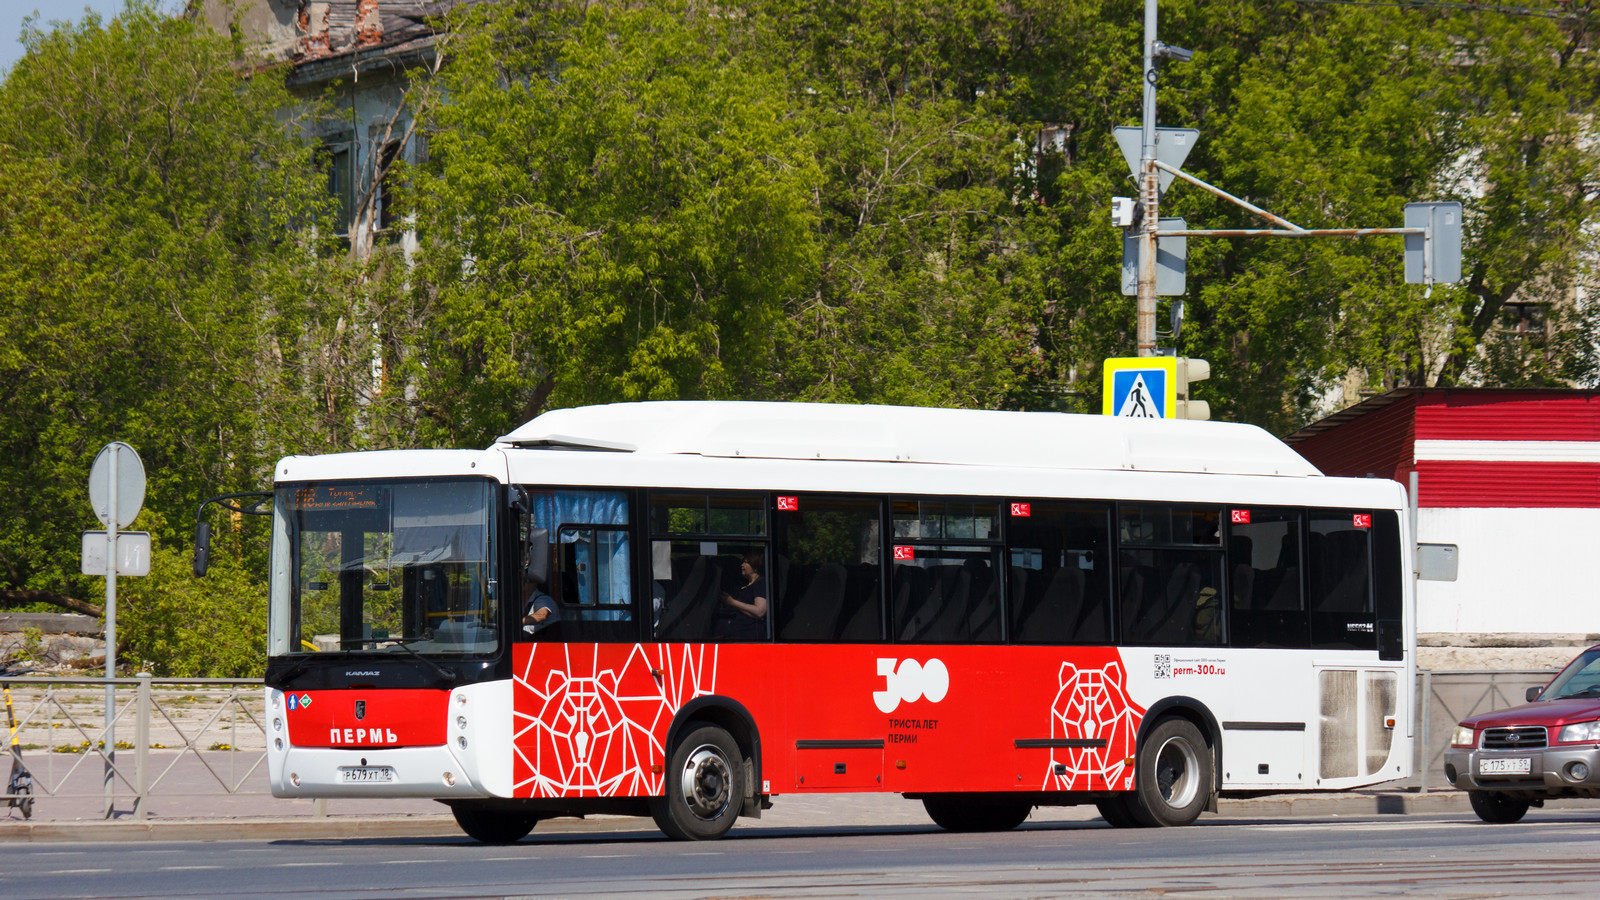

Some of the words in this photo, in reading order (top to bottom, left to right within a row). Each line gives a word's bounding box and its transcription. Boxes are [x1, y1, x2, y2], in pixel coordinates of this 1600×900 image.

[1173, 664, 1226, 678] perm-300.ru
[872, 658, 950, 714] 300
[888, 719, 922, 729] ТРИСТА
[922, 719, 939, 729] ЛЕТ
[330, 728, 398, 743] ПЕРМЬ
[888, 734, 918, 743] ПЕРМИ
